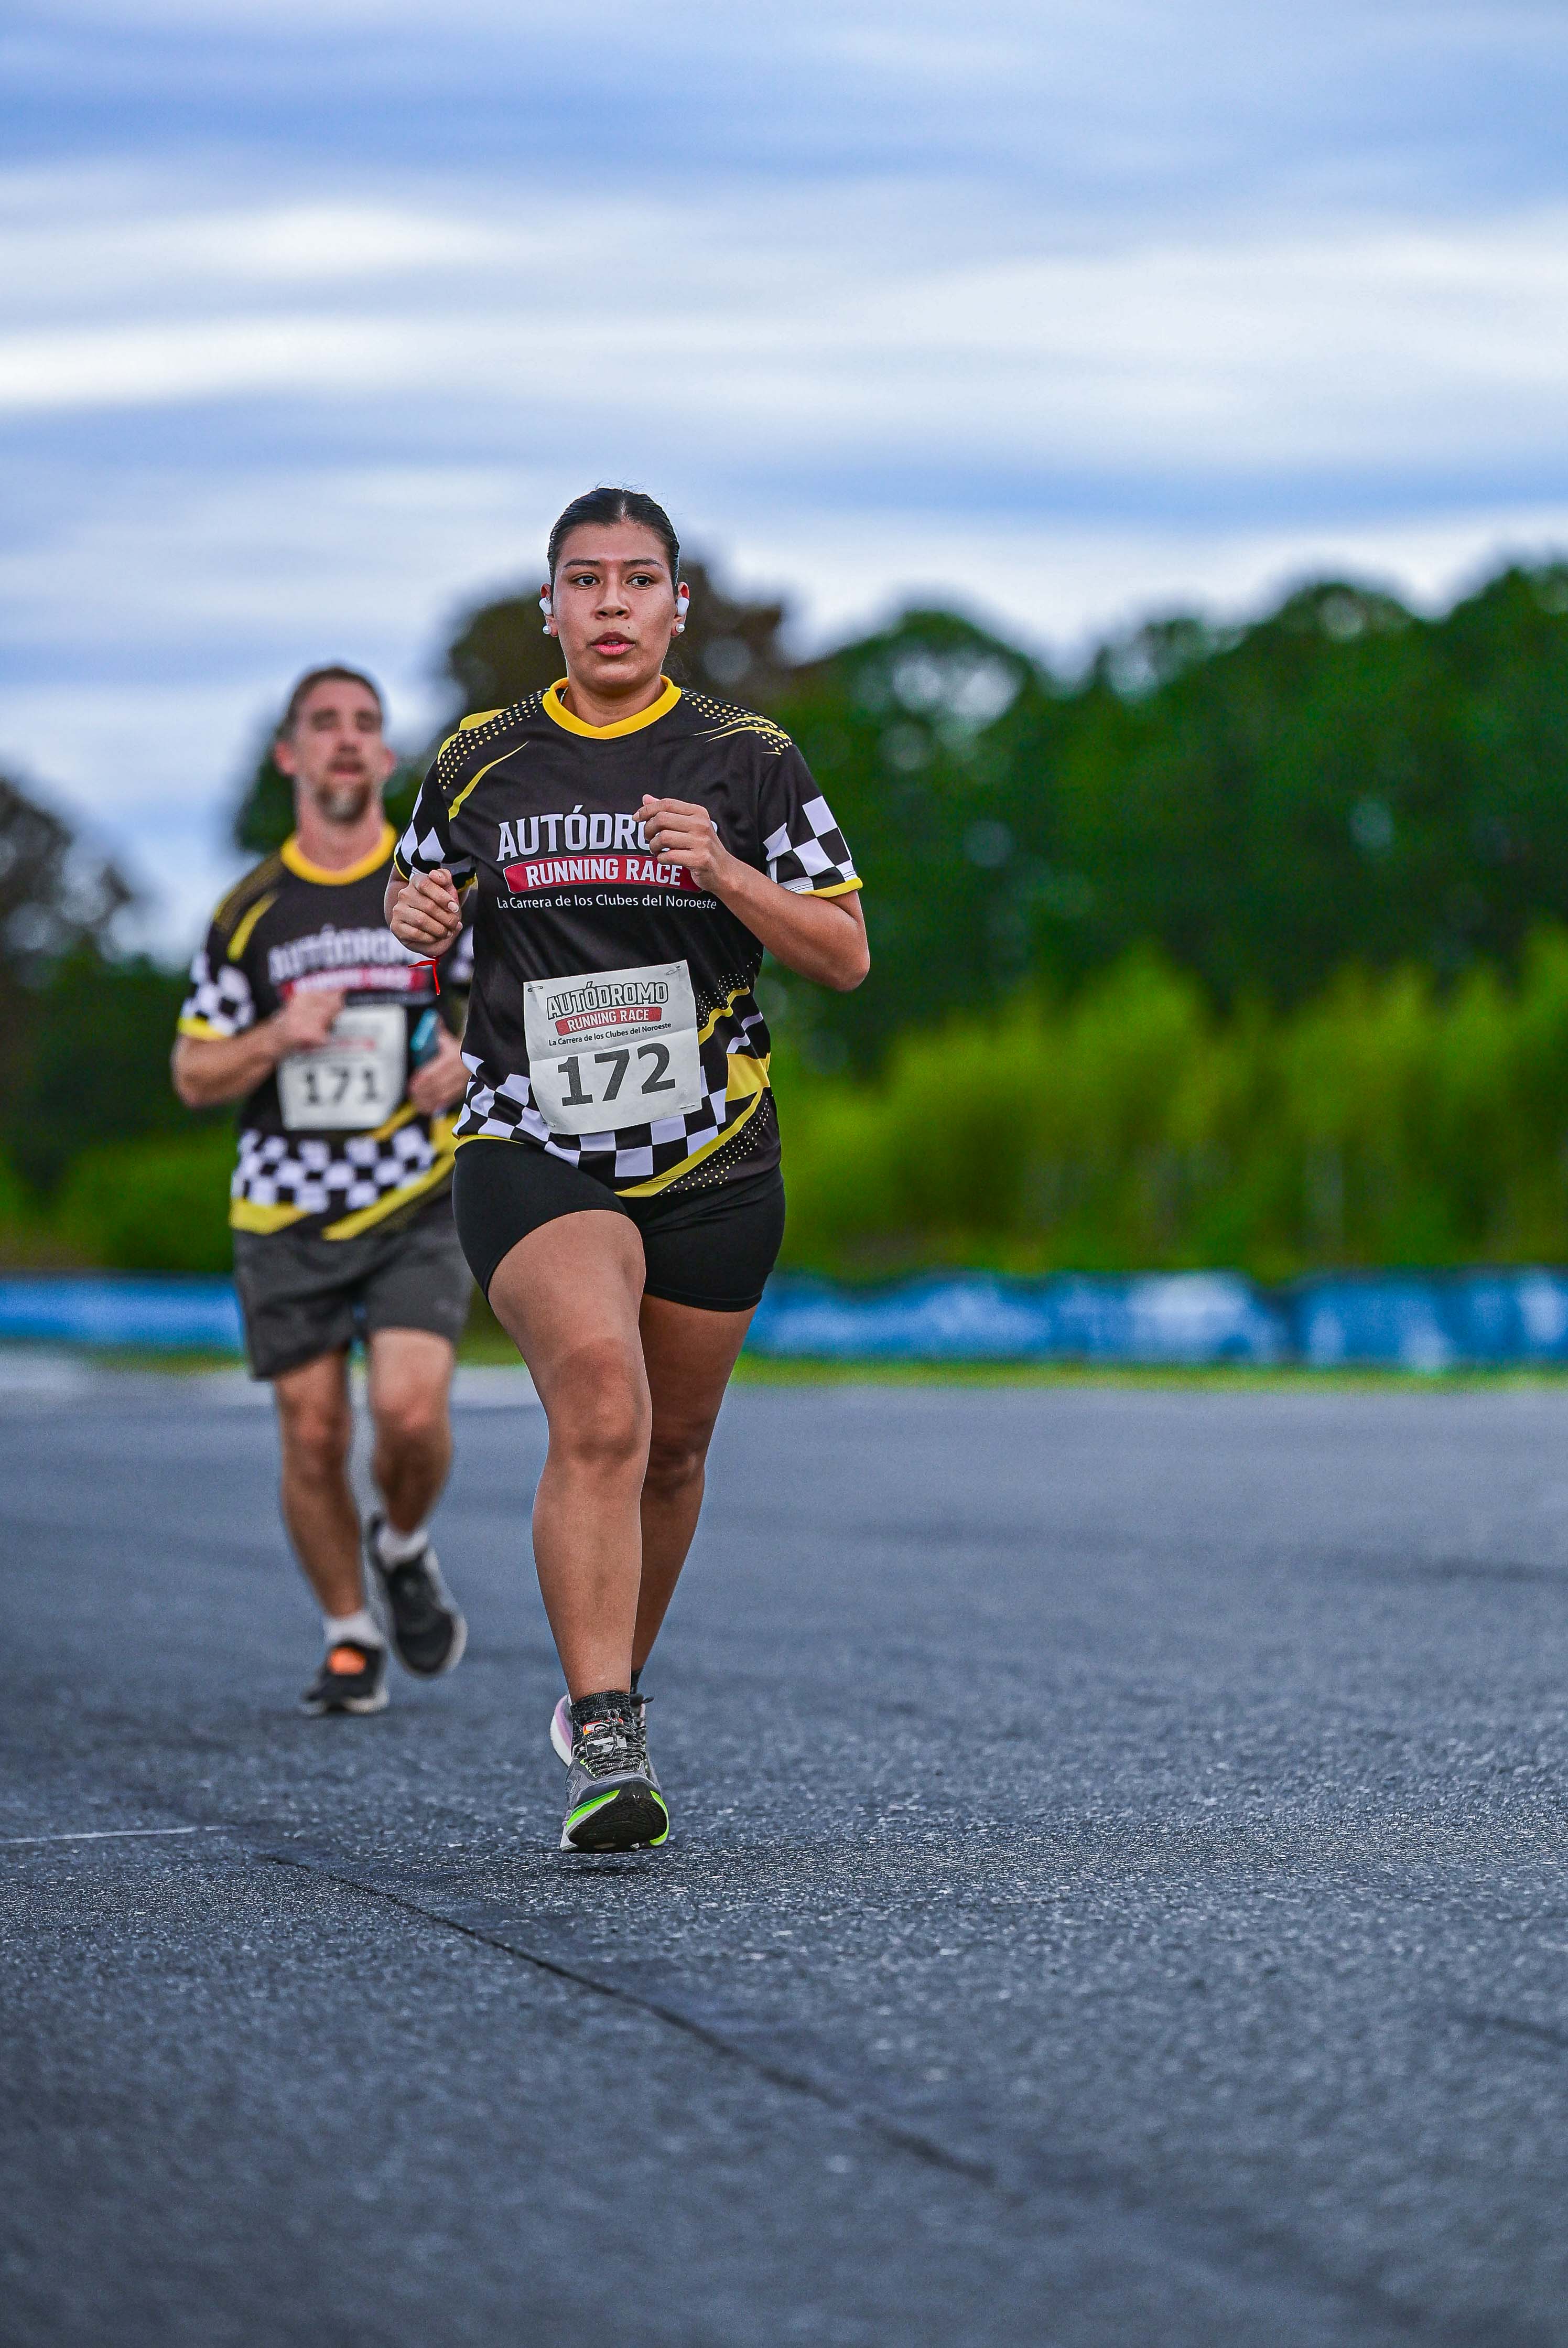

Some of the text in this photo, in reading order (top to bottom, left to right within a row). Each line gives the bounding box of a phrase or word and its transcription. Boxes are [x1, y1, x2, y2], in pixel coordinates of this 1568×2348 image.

[496, 804, 718, 861] AUTÓDR
[525, 858, 683, 887] RUNNING RACE
[496, 894, 717, 909] La Carrera de los Clubes del Noroeste
[547, 981, 669, 1020] AUTÓDROMO
[558, 1037, 582, 1045] Carrera
[605, 1030, 629, 1038] Clubes
[642, 1022, 672, 1033] Noroeste
[567, 1009, 649, 1032] RUNNING RACE
[304, 1065, 378, 1106] 171
[557, 1043, 676, 1106] 172
